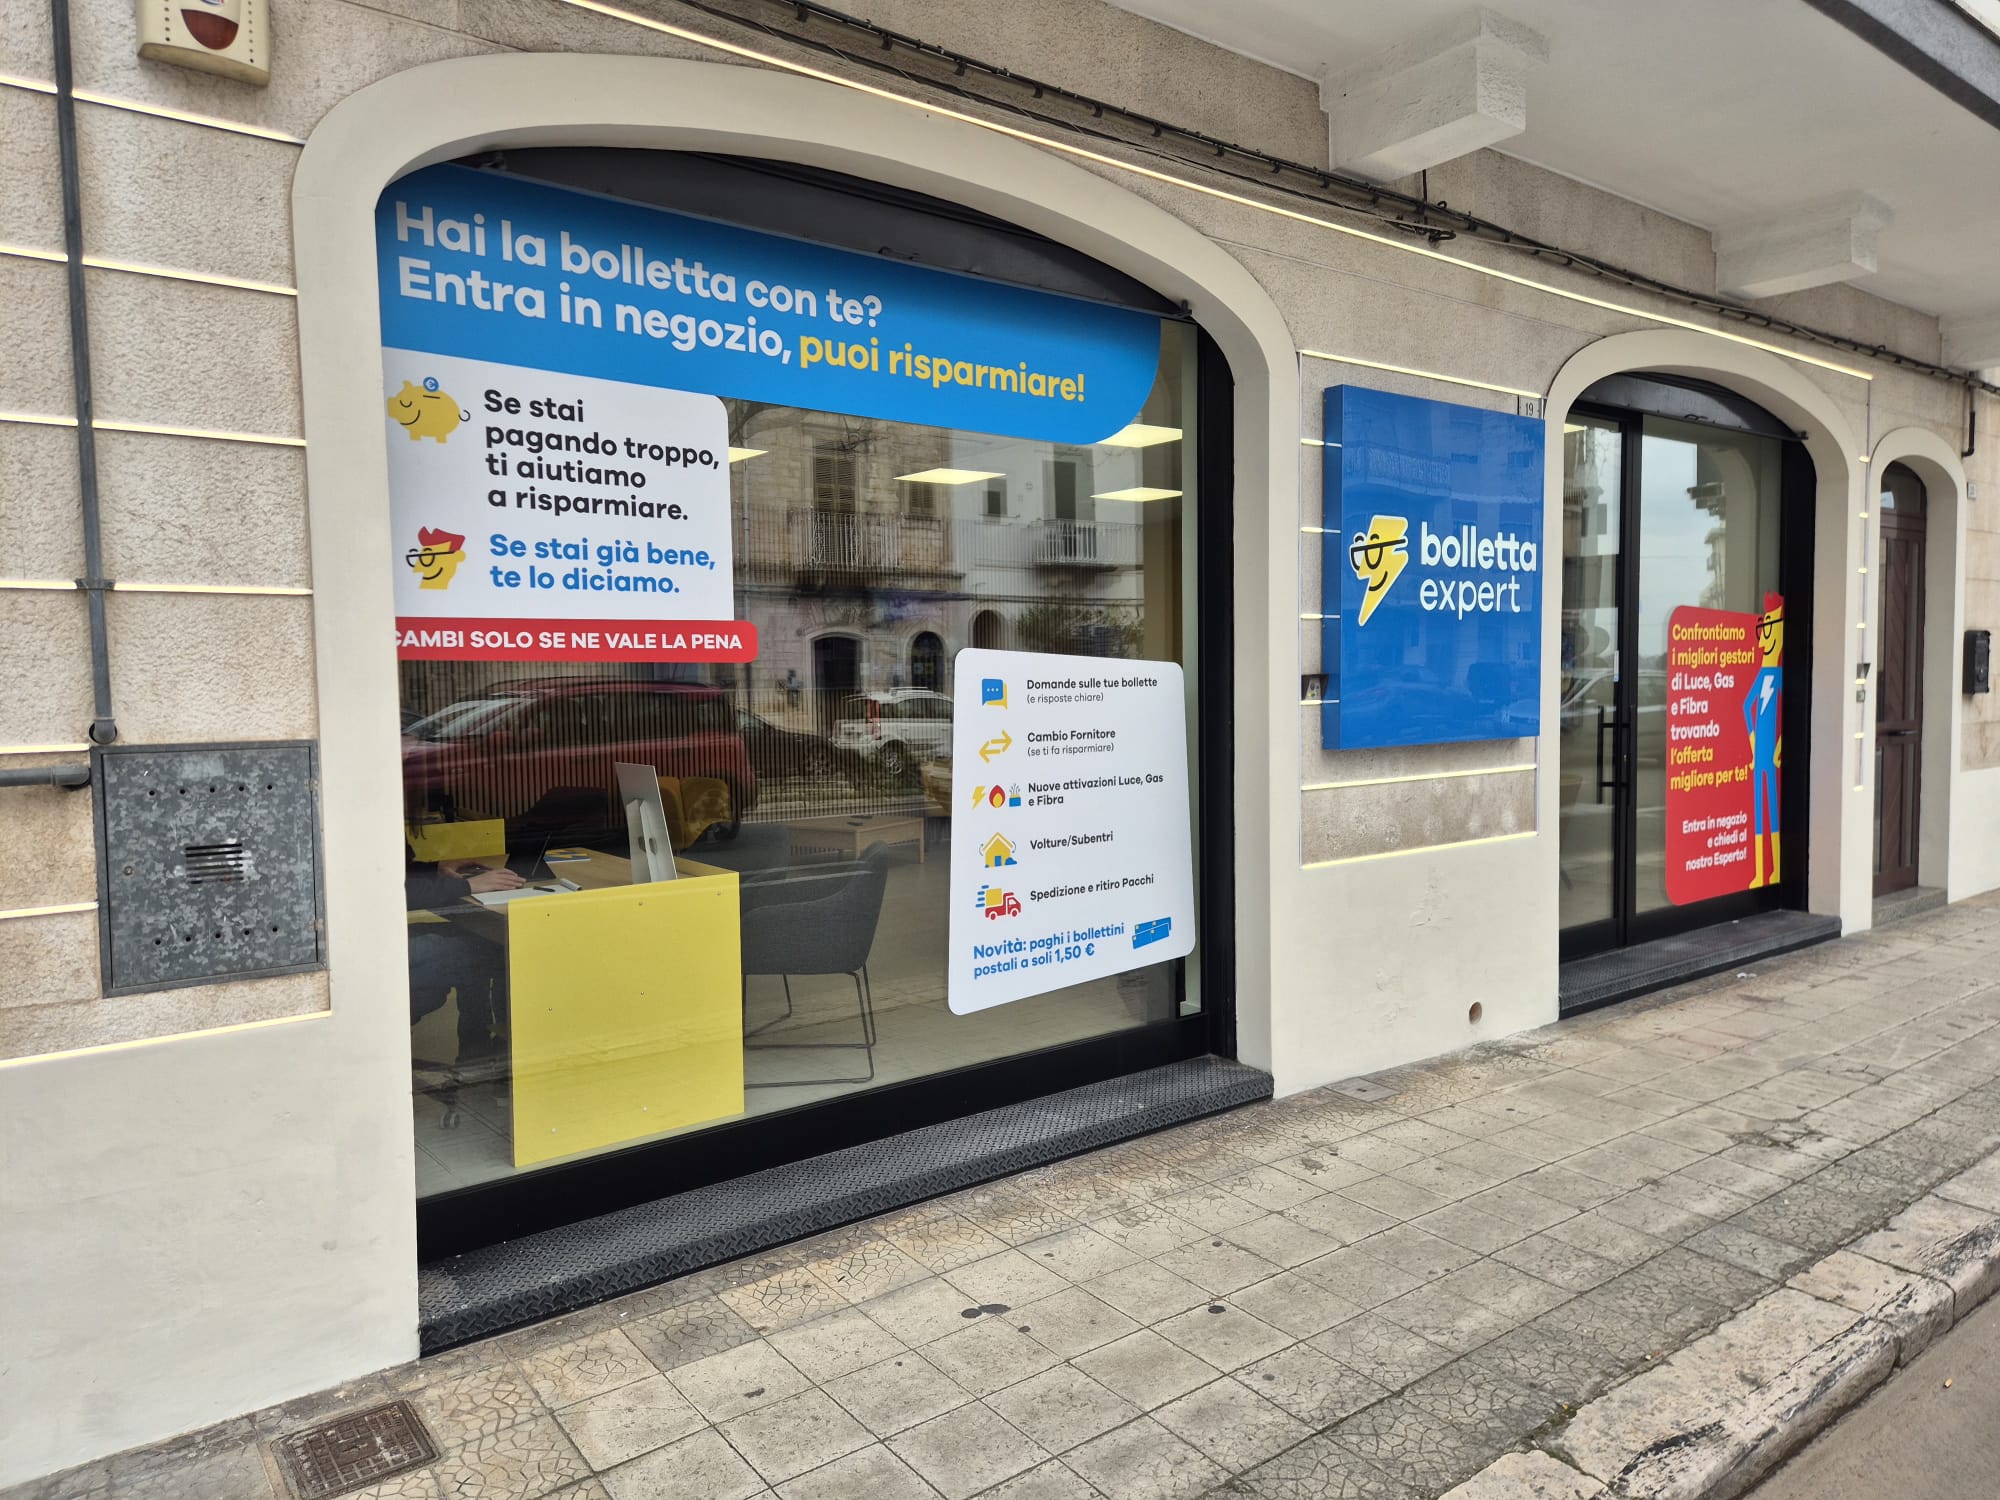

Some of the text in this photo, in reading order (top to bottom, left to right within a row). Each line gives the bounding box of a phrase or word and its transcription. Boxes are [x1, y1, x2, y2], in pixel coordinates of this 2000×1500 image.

[396, 201, 882, 327] Hai la bolletta con te?
[398, 256, 1085, 401] Entra in negozio, puoi risparmiare!
[484, 389, 584, 422] Se stai
[485, 425, 719, 469] pagando troppo,
[485, 453, 646, 488] ti aiutiamo
[488, 486, 688, 520] a risparmiare.
[489, 533, 715, 570] Se stai già bene,
[1420, 521, 1537, 572] bolletta
[490, 565, 680, 593] te lo diciamo.
[1419, 575, 1521, 621] expert
[470, 631, 533, 648] SOLO
[539, 631, 566, 649] SE
[571, 632, 600, 649] NE
[605, 632, 657, 649] VALE
[661, 633, 687, 649] LA
[691, 633, 743, 650] PENA
[1672, 623, 1746, 641] Confrontiamo
[1672, 647, 1755, 669] i migliori gestori
[1027, 677, 1158, 690] Domande sulle tue bollette
[1671, 672, 1734, 691] di Luce, Gas
[1027, 692, 1104, 704] (e risposte chiare)
[1671, 697, 1708, 715] e Fibra
[1027, 729, 1116, 743] Cambio Fornitore
[1671, 720, 1720, 740] trovando
[1027, 743, 1114, 757] (se ti fa risparmiare)
[1028, 773, 1164, 793] Nuove attivazioni Luce, Gas
[1670, 764, 1748, 792] migliore per te!
[1028, 795, 1064, 807] e Fibra
[1682, 810, 1748, 835] Entra in negozio
[1030, 831, 1114, 850] Volture/Subentri
[1707, 828, 1747, 848] e chiedi al
[1685, 847, 1747, 872] nostro Esperto!
[1030, 874, 1154, 902] Spedizione e ritiro Pacchi
[973, 923, 1125, 960] Novità: paghi i bollettini
[974, 942, 1095, 980] postali a soli 1,50 €
